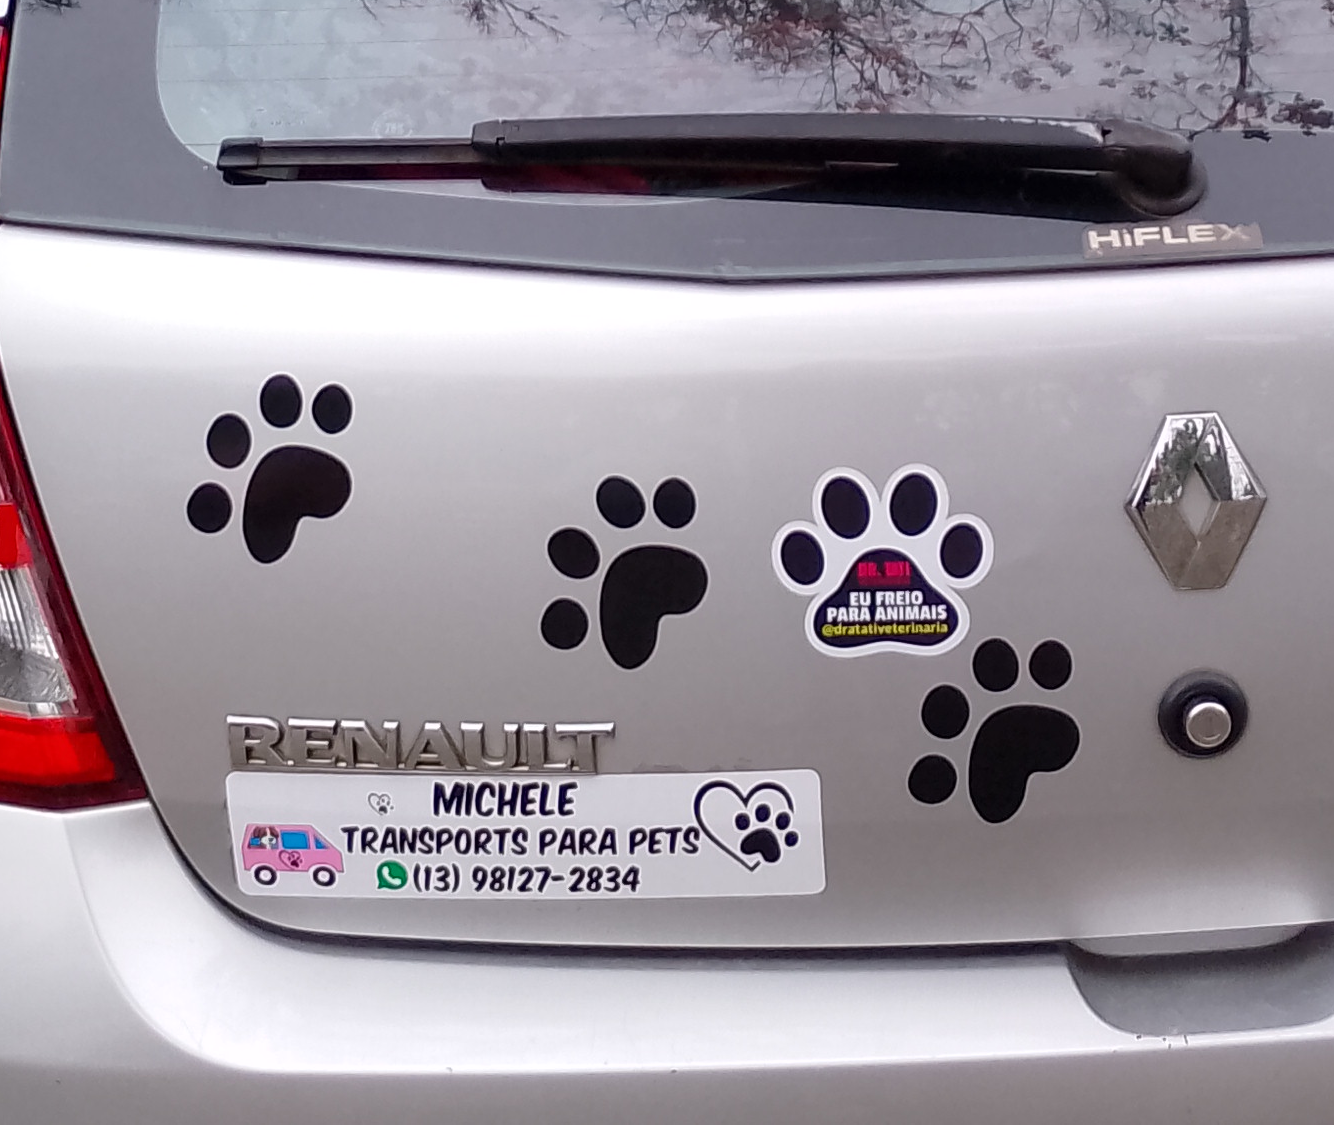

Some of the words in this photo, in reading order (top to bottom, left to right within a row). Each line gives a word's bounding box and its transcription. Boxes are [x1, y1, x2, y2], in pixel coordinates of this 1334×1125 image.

[849, 592, 871, 606] EU
[875, 590, 924, 605] FREIO
[826, 607, 871, 623] PARA
[875, 604, 948, 621] ANIMAIS
[226, 714, 616, 773] RENAULT
[433, 782, 578, 816] MICHELE
[341, 826, 528, 855] TRANSPORTS
[538, 826, 618, 855] PARA
[629, 826, 700, 854] PETS
[413, 863, 461, 893] (13)
[472, 865, 640, 893] 98127-2834
